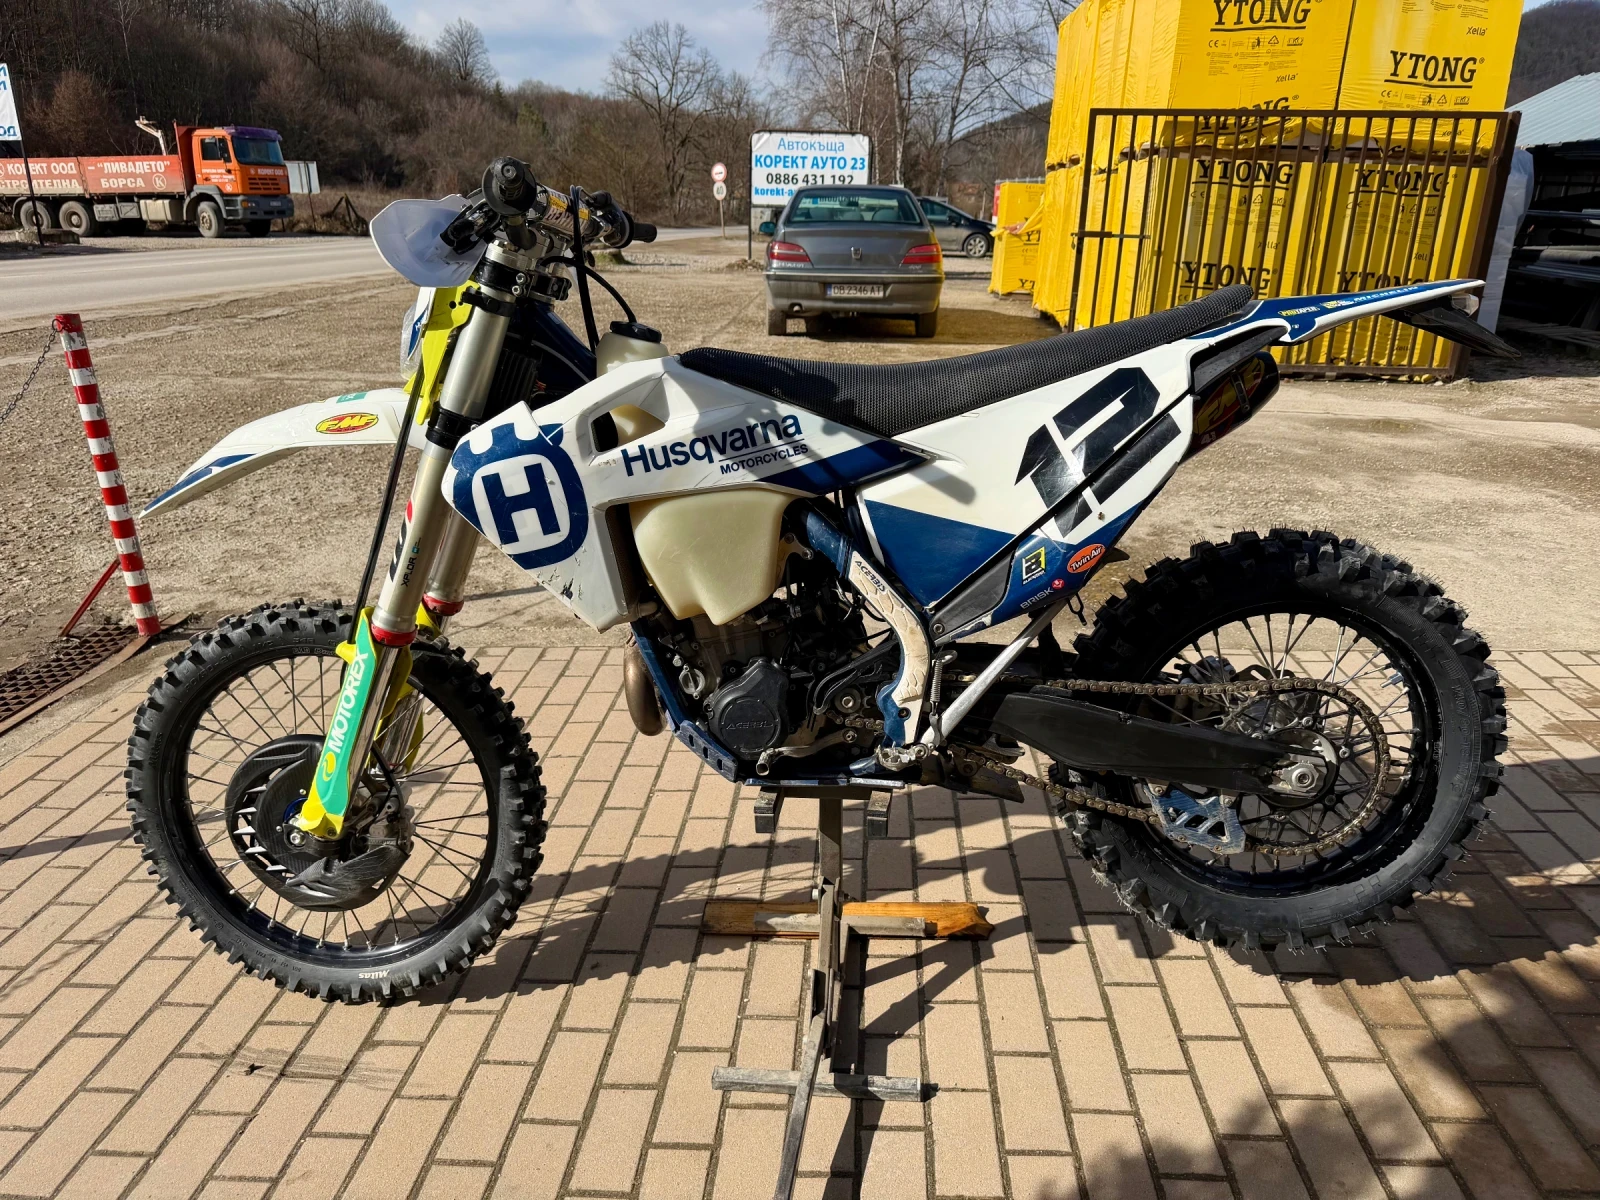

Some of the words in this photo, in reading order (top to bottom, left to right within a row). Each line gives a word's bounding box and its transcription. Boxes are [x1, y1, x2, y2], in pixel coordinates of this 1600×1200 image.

[1389, 50, 1478, 83] YTONG
[777, 137, 845, 153] Автокъща
[50, 161, 77, 175] ООД
[754, 154, 808, 169] КОРЕКТ
[810, 156, 847, 170] АУТО
[850, 157, 866, 171] 23
[1197, 159, 1293, 185] YTONG
[100, 177, 146, 189] БОРСА
[766, 172, 799, 185] 0886
[801, 173, 825, 185] 431
[830, 174, 854, 185] 192
[846, 285, 869, 296] 2346
[870, 285, 882, 296] AT
[317, 413, 378, 432] FMF
[620, 414, 803, 477] Husqvarna
[719, 443, 809, 475] MOTORCYCLES
[1069, 555, 1091, 573] Twin
[1089, 545, 1103, 560] Air
[401, 556, 417, 588] XPLOR
[854, 559, 886, 593] ACERBIS
[1020, 586, 1055, 610] BRISK
[327, 651, 369, 754] MOTOREX
[358, 969, 390, 980] Mitas
